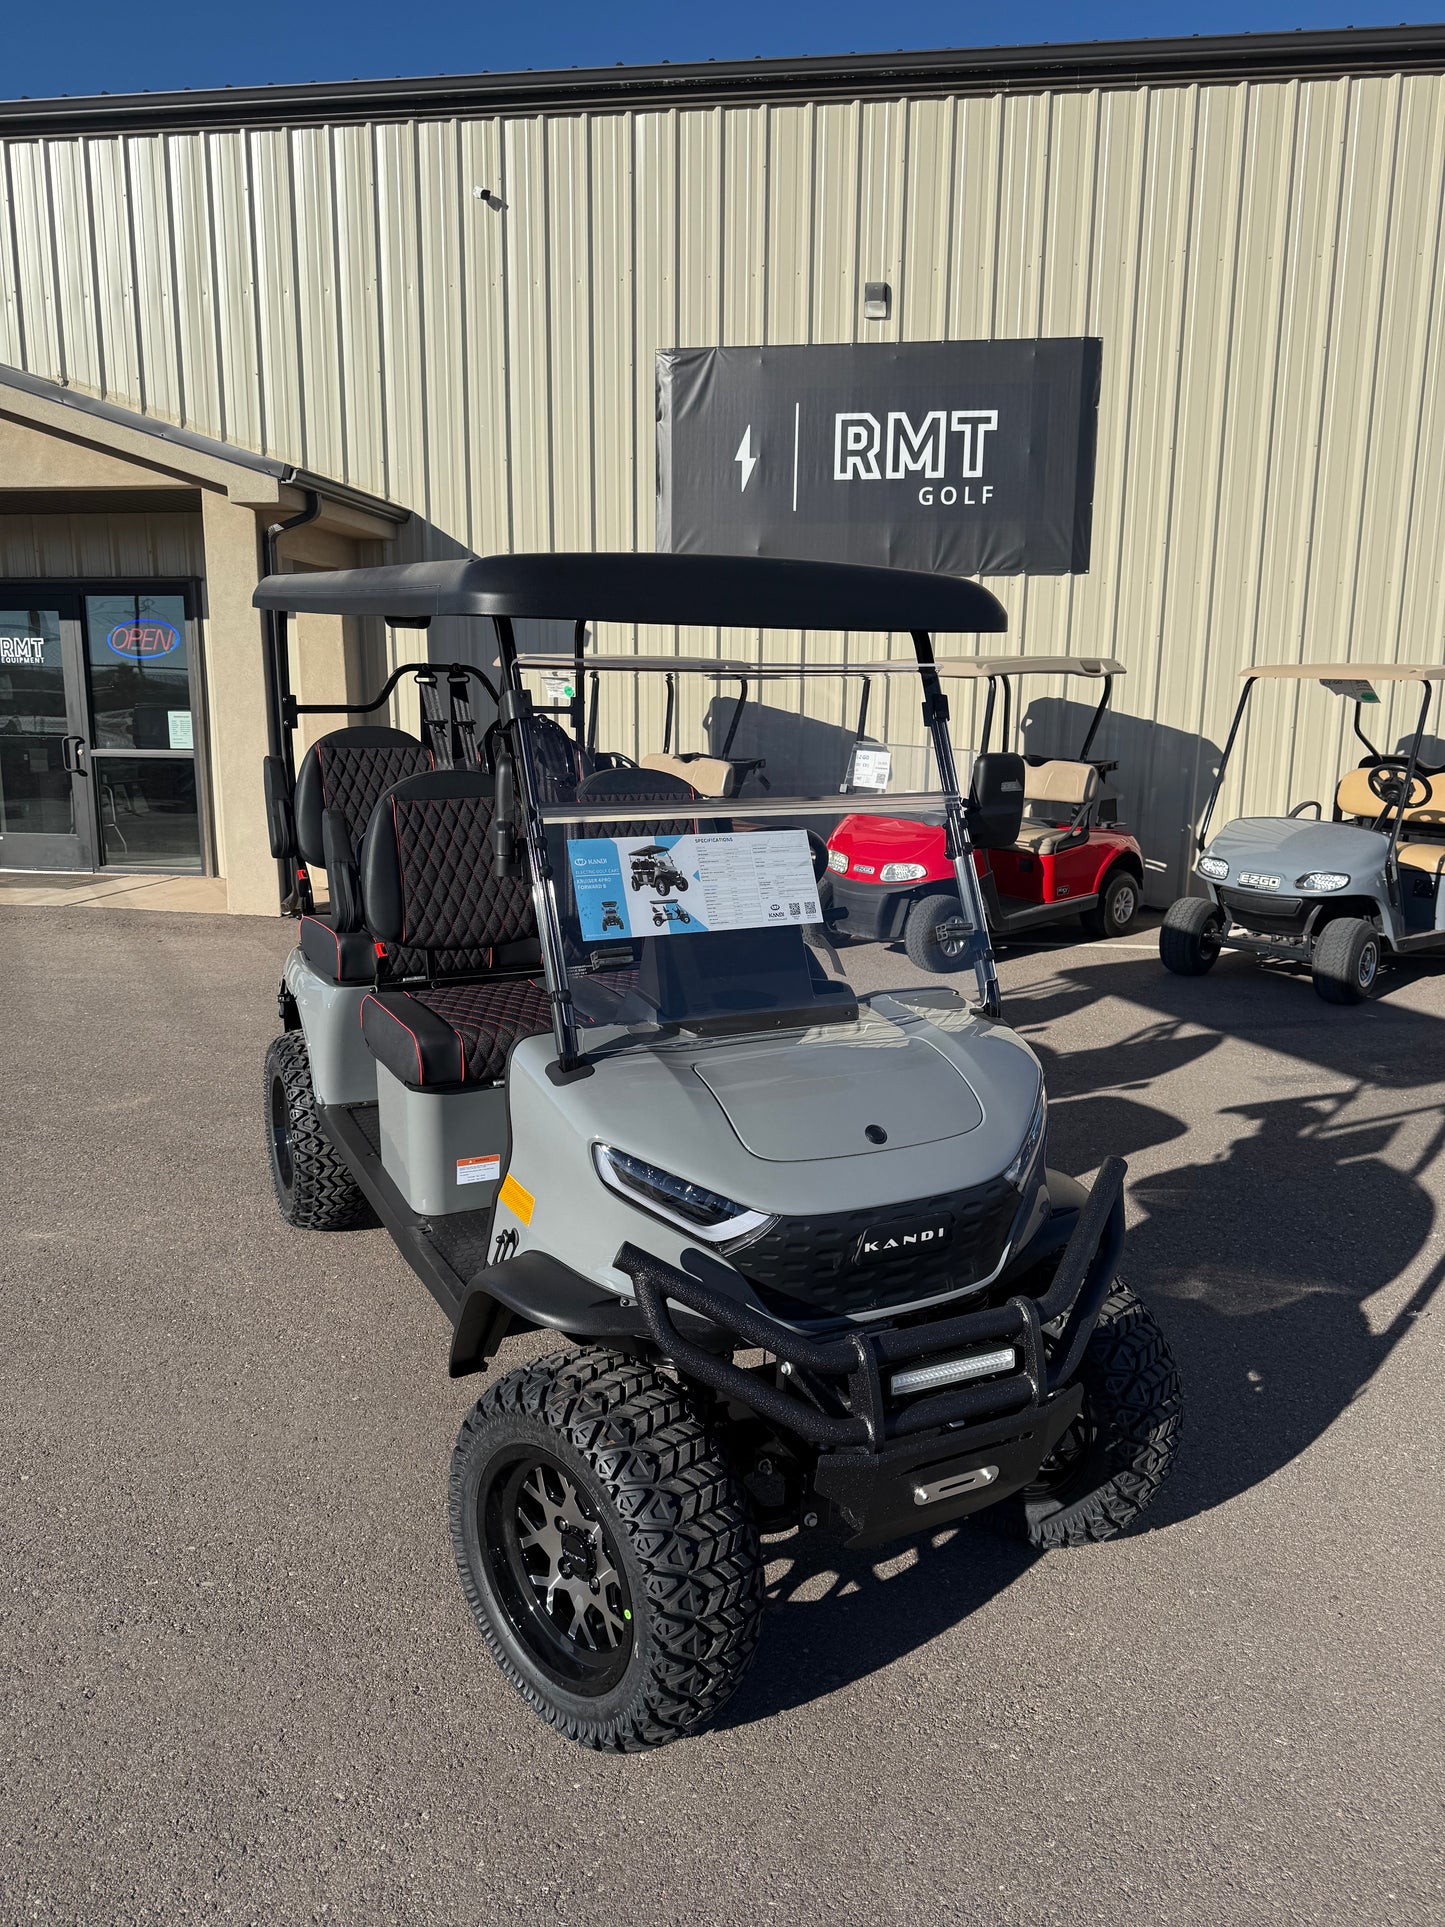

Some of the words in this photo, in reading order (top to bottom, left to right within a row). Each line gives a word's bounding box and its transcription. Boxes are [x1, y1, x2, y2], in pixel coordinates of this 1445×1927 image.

[834, 410, 998, 480] RMT
[918, 485, 994, 506] GOLF
[0, 637, 44, 657] RMT
[112, 627, 174, 652] OPEN
[1, 656, 45, 664] EQUIPMENT
[587, 857, 608, 865] KANDI
[864, 1227, 944, 1253] KANDI
